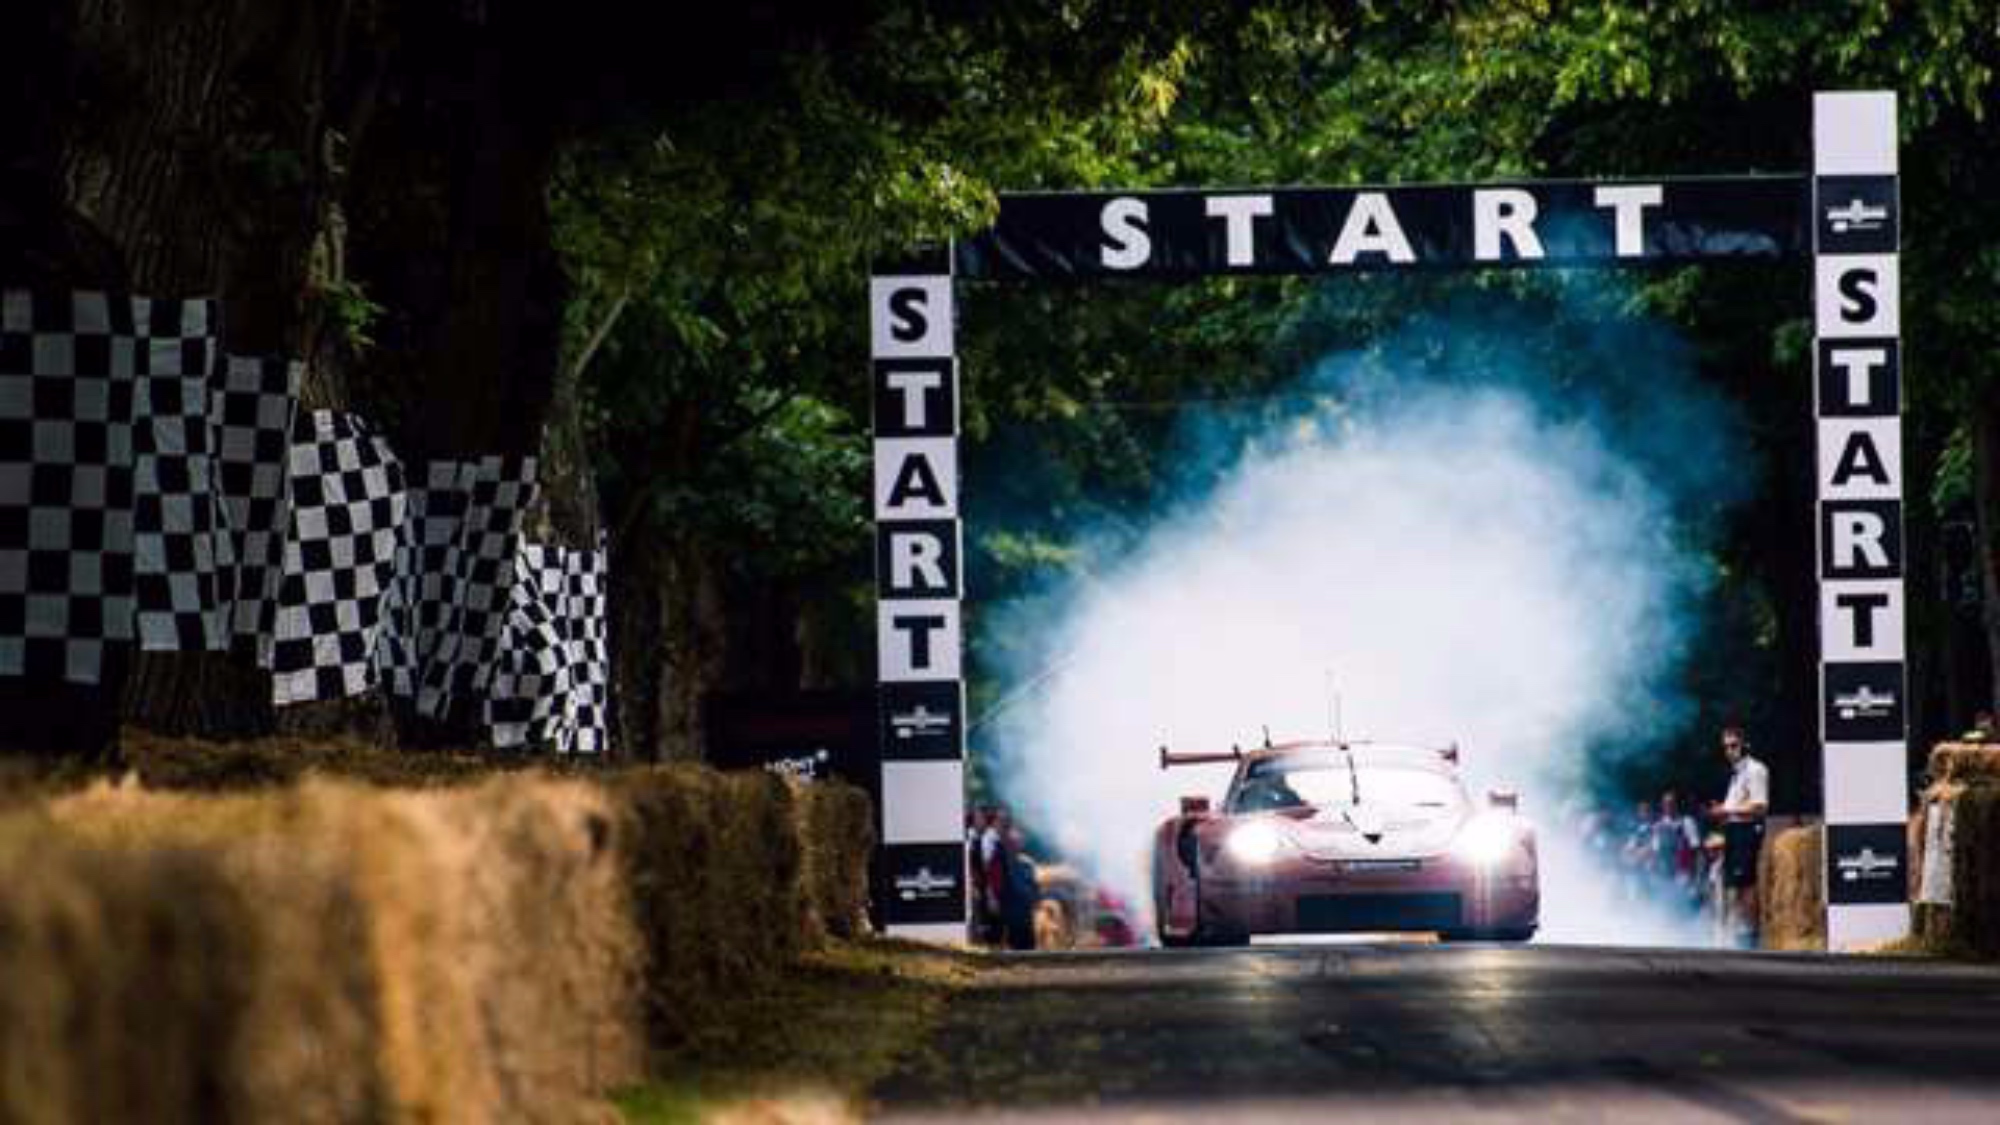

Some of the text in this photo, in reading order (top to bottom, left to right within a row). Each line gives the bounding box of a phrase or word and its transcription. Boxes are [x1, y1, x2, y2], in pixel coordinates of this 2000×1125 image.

[1100, 185, 1662, 268] START
[887, 287, 947, 669] START
[1831, 268, 1890, 647] START
